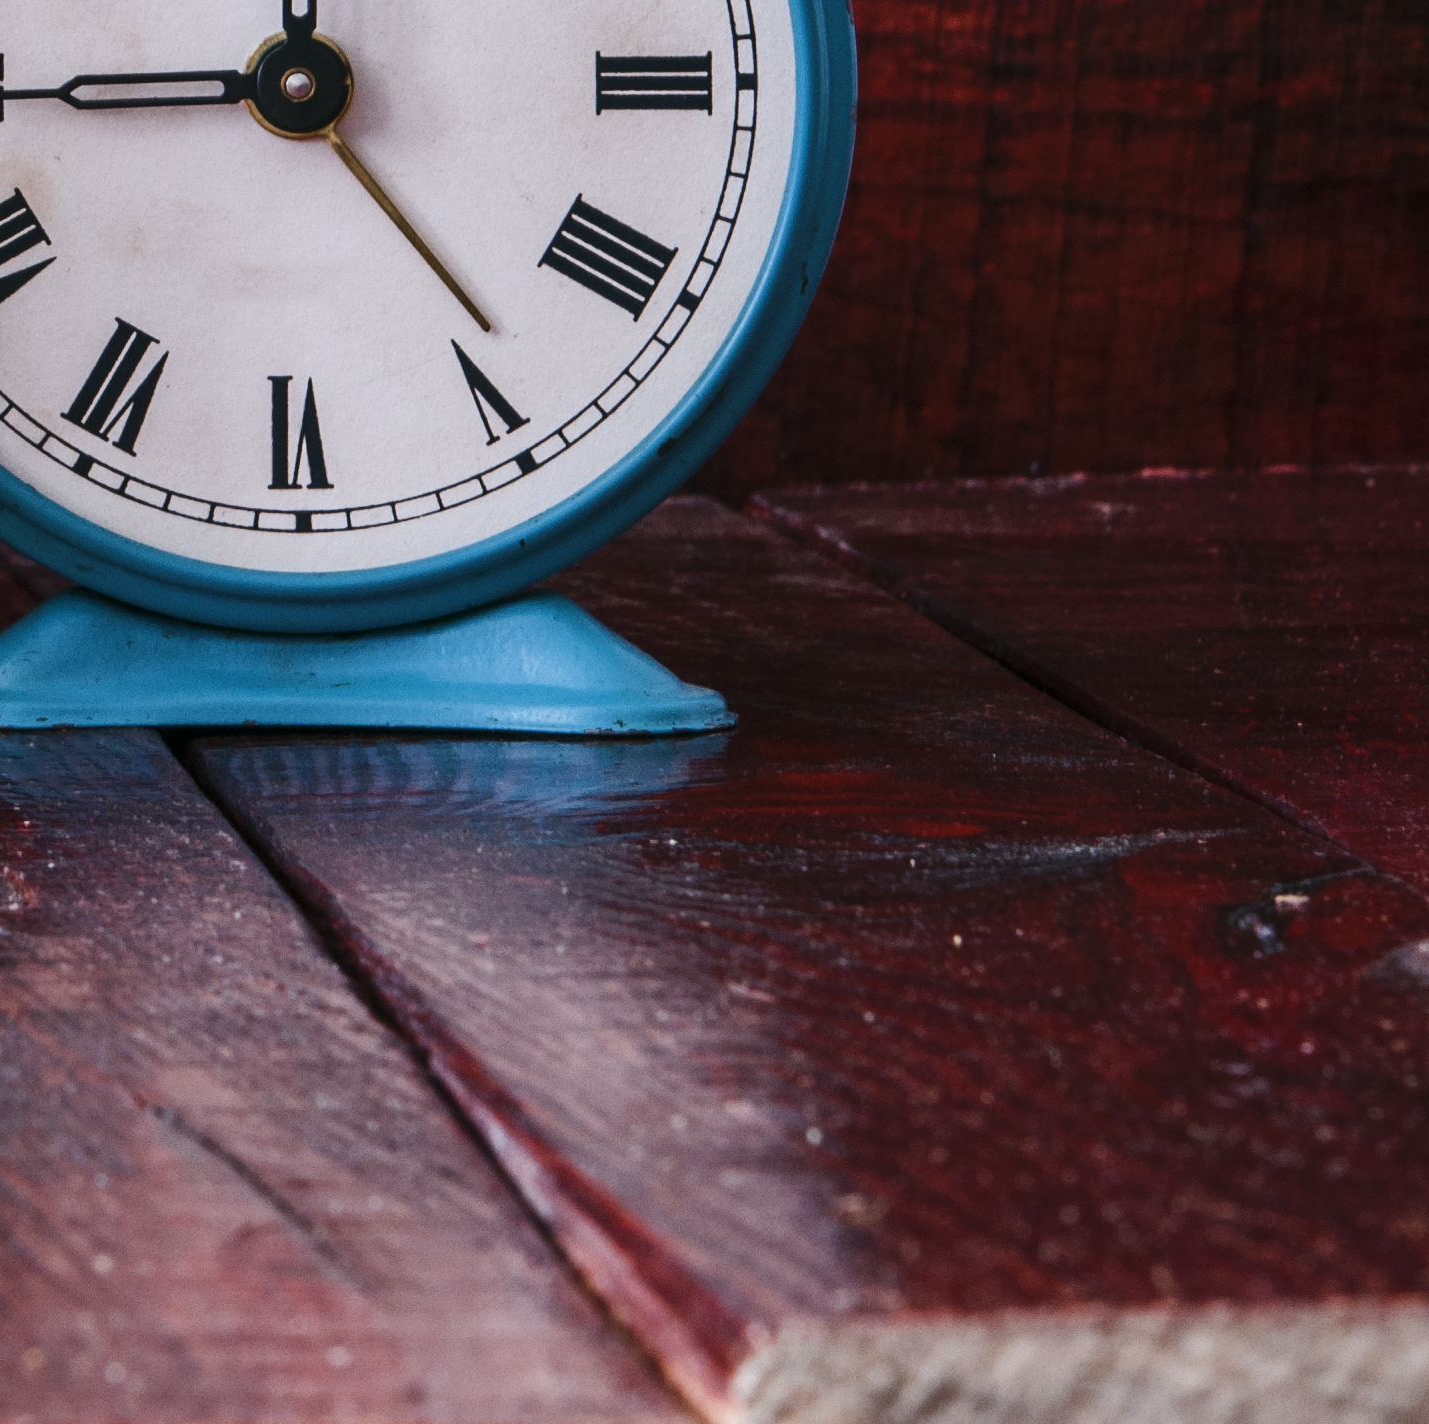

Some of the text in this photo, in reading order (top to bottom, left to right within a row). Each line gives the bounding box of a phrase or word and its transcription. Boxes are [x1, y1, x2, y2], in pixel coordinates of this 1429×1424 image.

[596, 51, 712, 115] III
[538, 193, 678, 322] IIII
[60, 317, 169, 457] VII
[268, 376, 334, 489] VI
[451, 339, 530, 445] V
